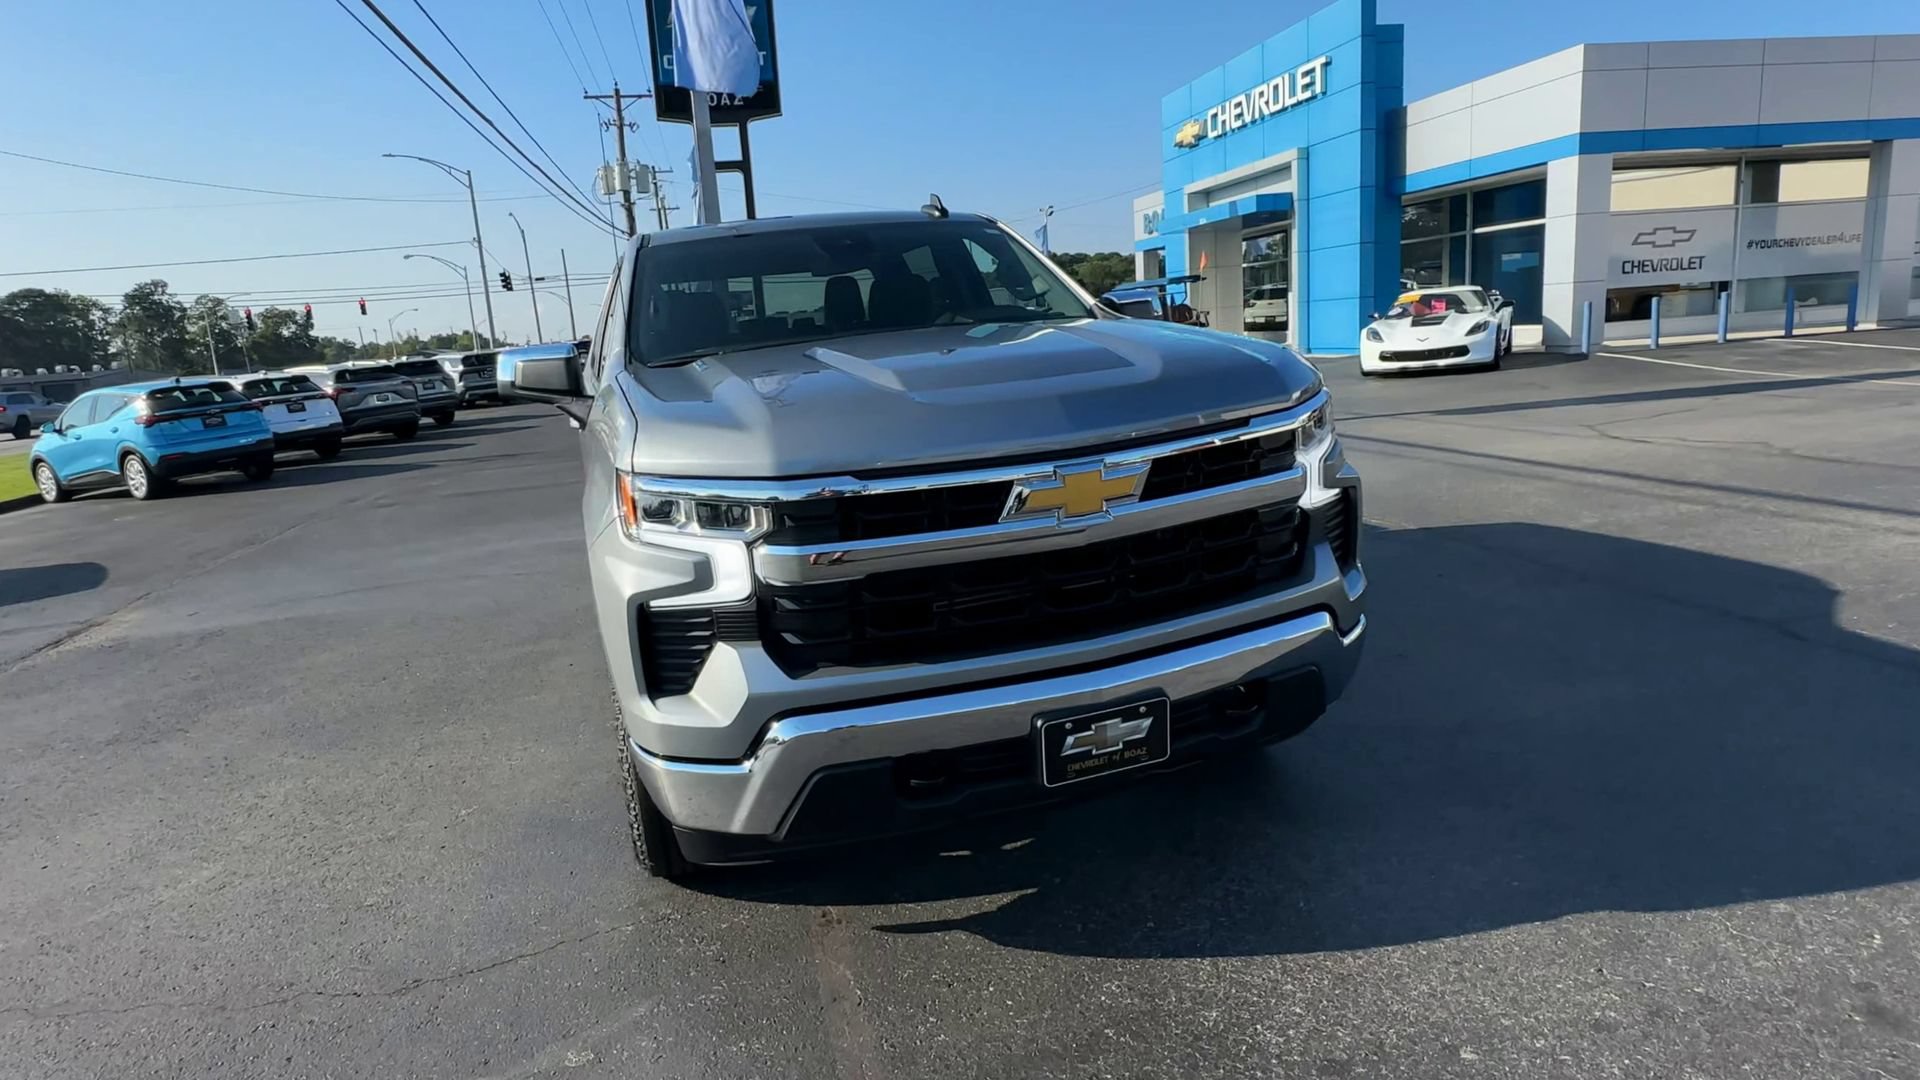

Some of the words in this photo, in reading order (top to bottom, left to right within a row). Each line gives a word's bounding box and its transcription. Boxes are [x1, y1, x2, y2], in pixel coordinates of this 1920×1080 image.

[1207, 56, 1331, 139] CHEVROLET
[1747, 232, 1862, 250] #YOURCHEVYDEALER4LIFE
[1621, 256, 1705, 275] CHEVROLET
[1067, 756, 1108, 771] CHEVROLET
[1124, 746, 1148, 759] BOAZ
